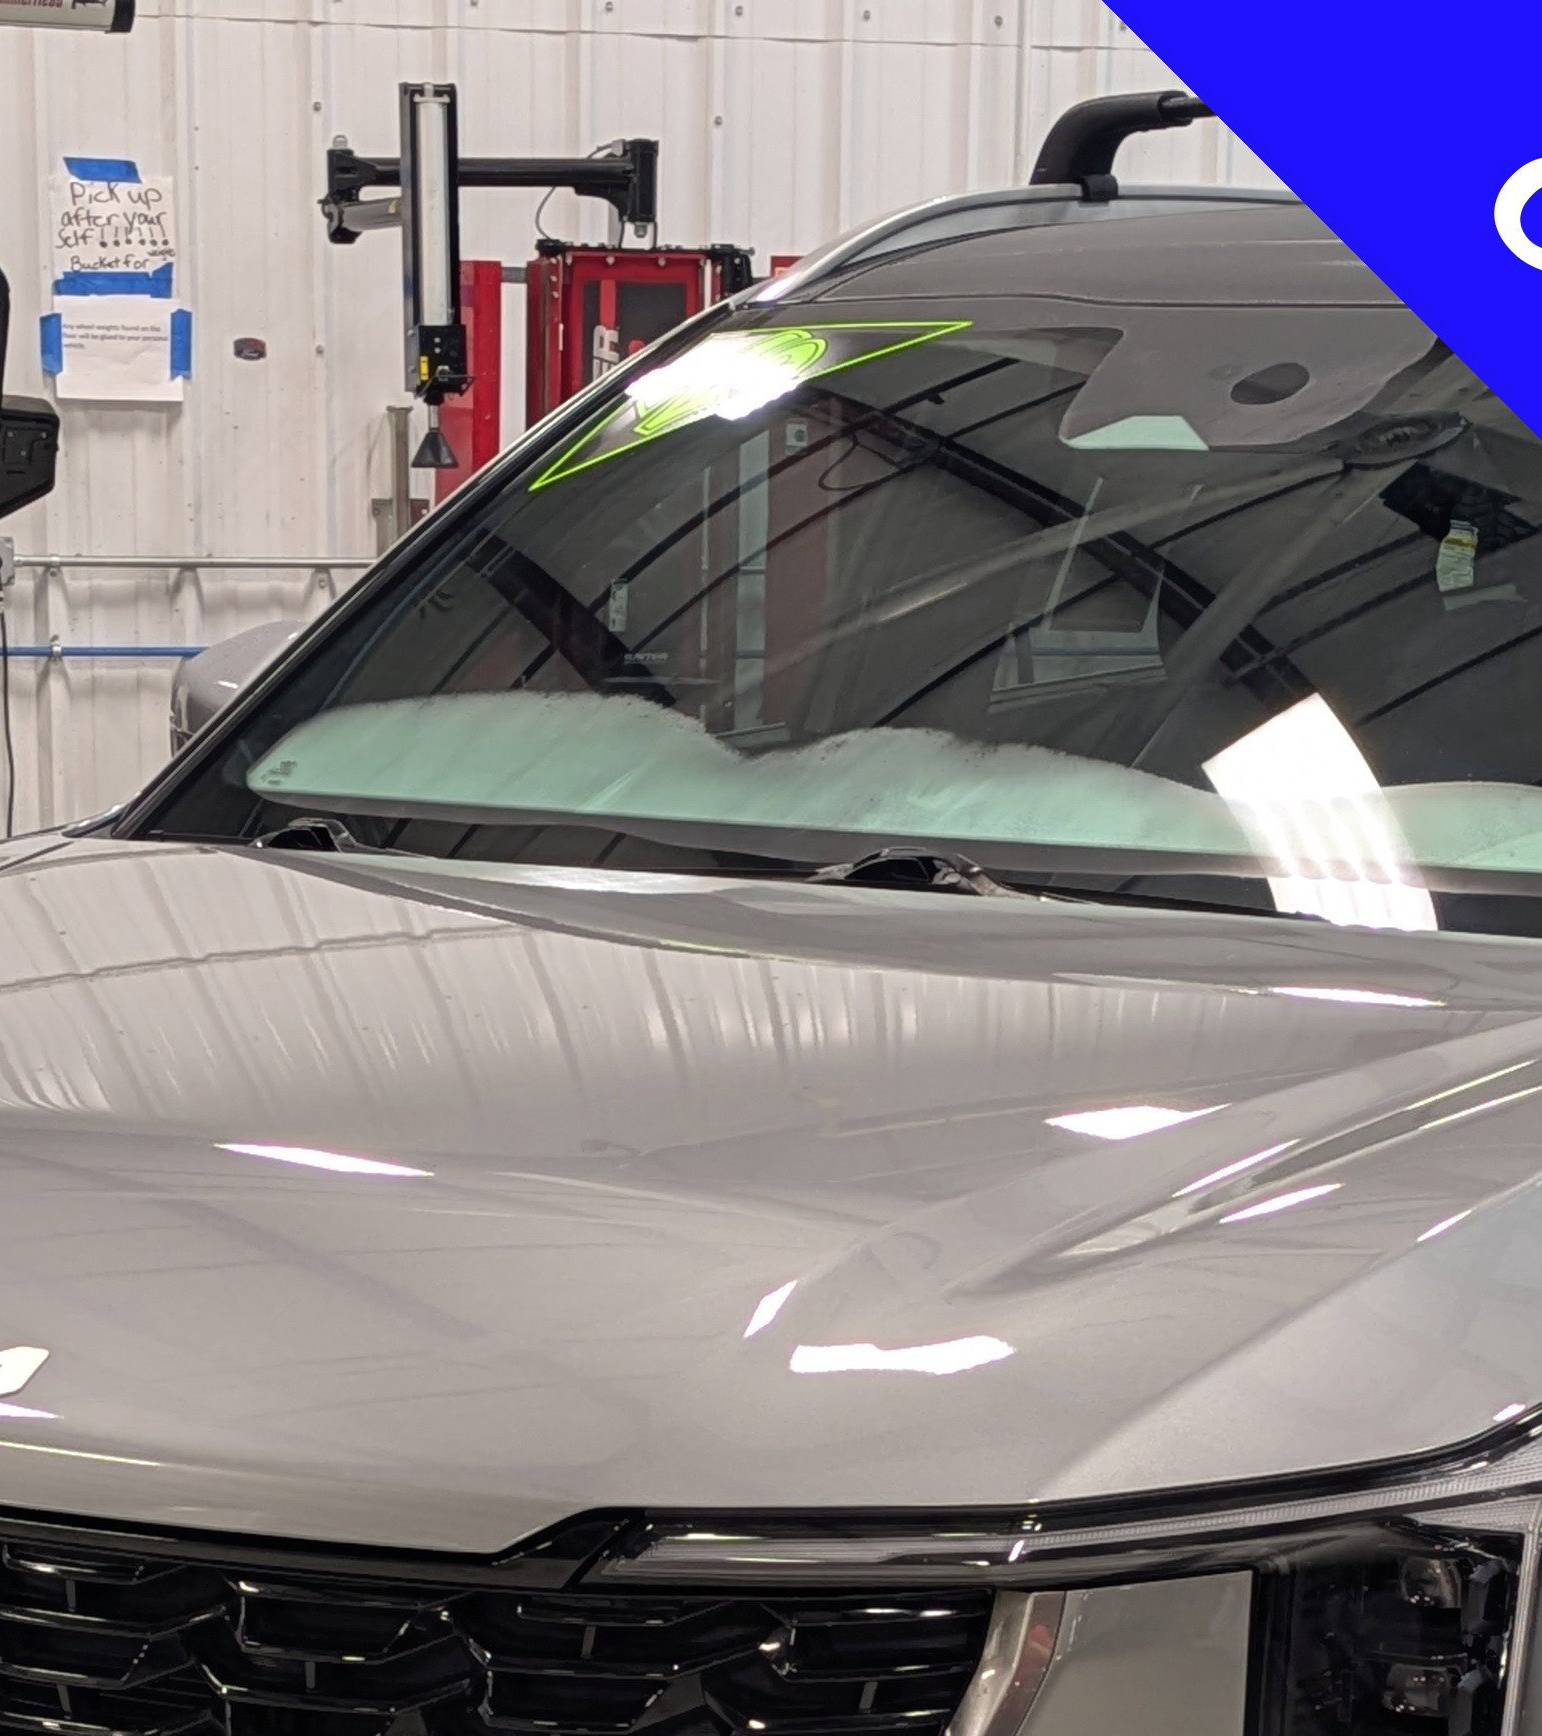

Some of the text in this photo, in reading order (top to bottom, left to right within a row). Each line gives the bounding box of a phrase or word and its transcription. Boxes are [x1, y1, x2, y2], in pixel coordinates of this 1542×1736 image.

[70, 181, 163, 210] Pick up
[61, 206, 167, 235] after your
